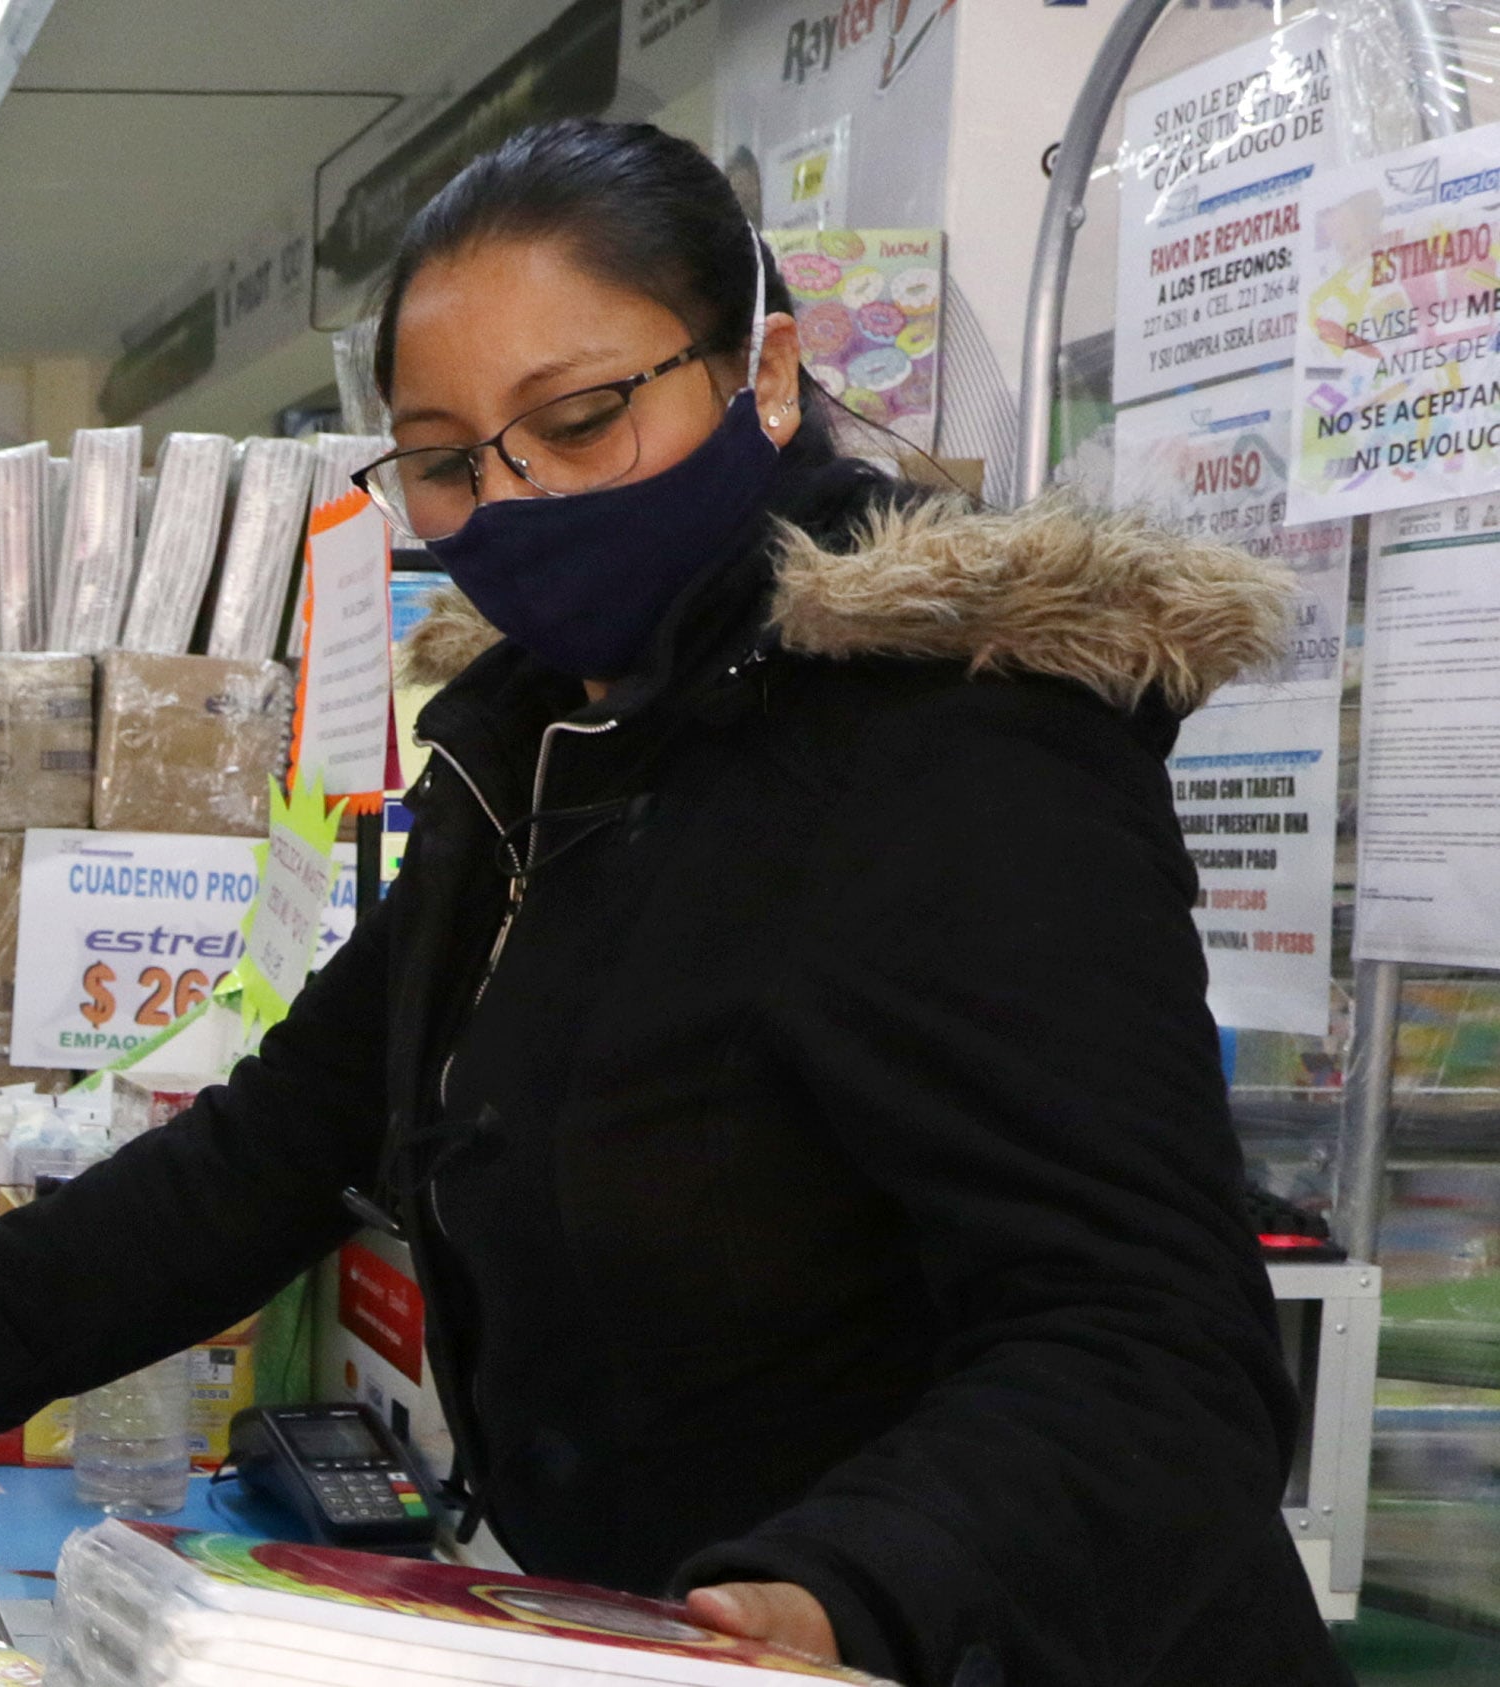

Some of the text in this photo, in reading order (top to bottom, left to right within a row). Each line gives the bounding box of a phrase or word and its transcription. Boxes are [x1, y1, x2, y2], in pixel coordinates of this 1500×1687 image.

[1174, 101, 1197, 130] NO
[1201, 89, 1221, 117] LE
[1225, 123, 1287, 164] LOGO
[1293, 108, 1324, 143] DE
[1151, 238, 1190, 276] FAVOR
[1193, 230, 1211, 262] DE
[1371, 222, 1492, 288] ESTIMADO
[1158, 247, 1293, 306] A LOS TELEFONOS:
[1237, 285, 1257, 309] 221
[1346, 307, 1419, 346] REVISE
[1427, 301, 1458, 327] SU
[1174, 334, 1220, 364] COMPRA
[1373, 334, 1488, 381] ANTES DE
[1318, 411, 1353, 439] NO
[1360, 404, 1386, 430] SE
[1193, 450, 1262, 497] AVISO
[1354, 446, 1380, 473] NI
[1247, 776, 1296, 798] TARJETA
[1216, 813, 1281, 834] PRESENTAR
[1246, 849, 1277, 870] PAGO
[69, 863, 199, 900] CUADERNO
[79, 960, 117, 1030] $
